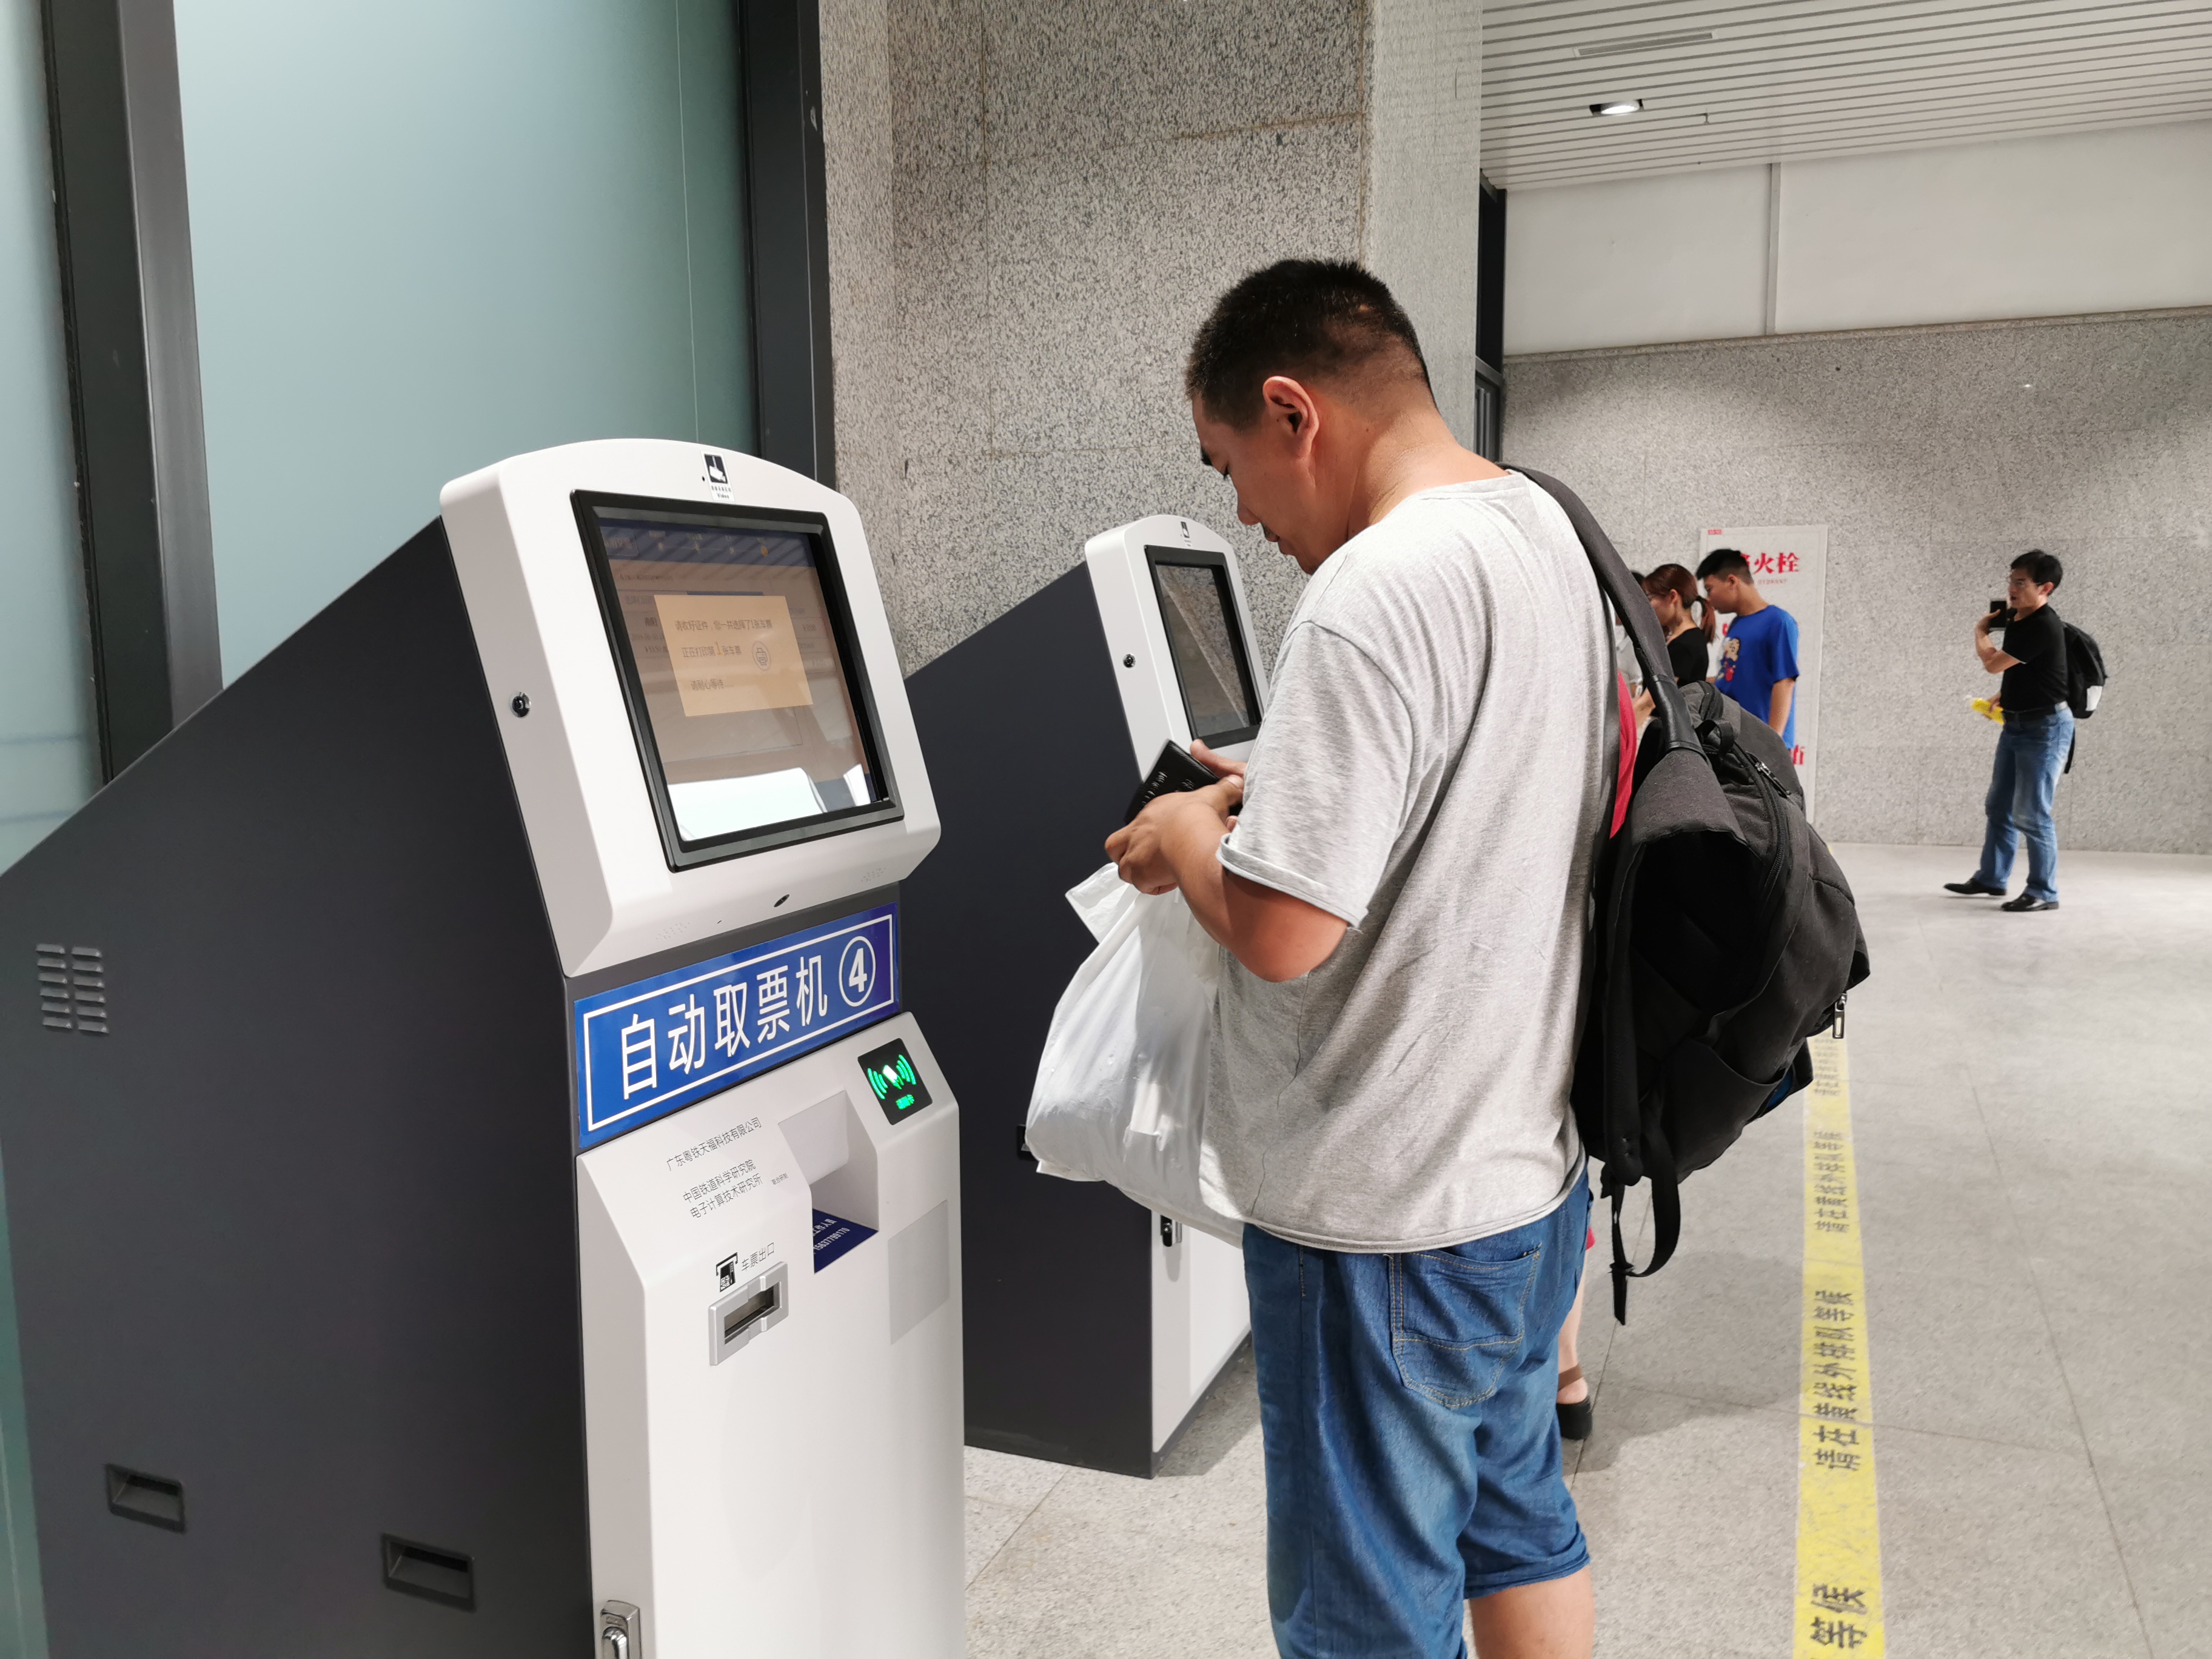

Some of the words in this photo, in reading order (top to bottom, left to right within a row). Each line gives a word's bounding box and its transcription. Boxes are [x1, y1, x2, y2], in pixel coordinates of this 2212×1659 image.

[621, 954, 828, 1100] 自动取票机
[666, 1117, 762, 1171] 广东粤铁天福科技有限公司
[683, 1159, 756, 1204] 中国铁道科学研究院
[690, 1173, 763, 1218] 电子计算技术研究所
[813, 1218, 837, 1236] 工作人员
[742, 1242, 774, 1272] 车票出口
[1812, 1290, 1861, 1472] 请在黄线外排队等候
